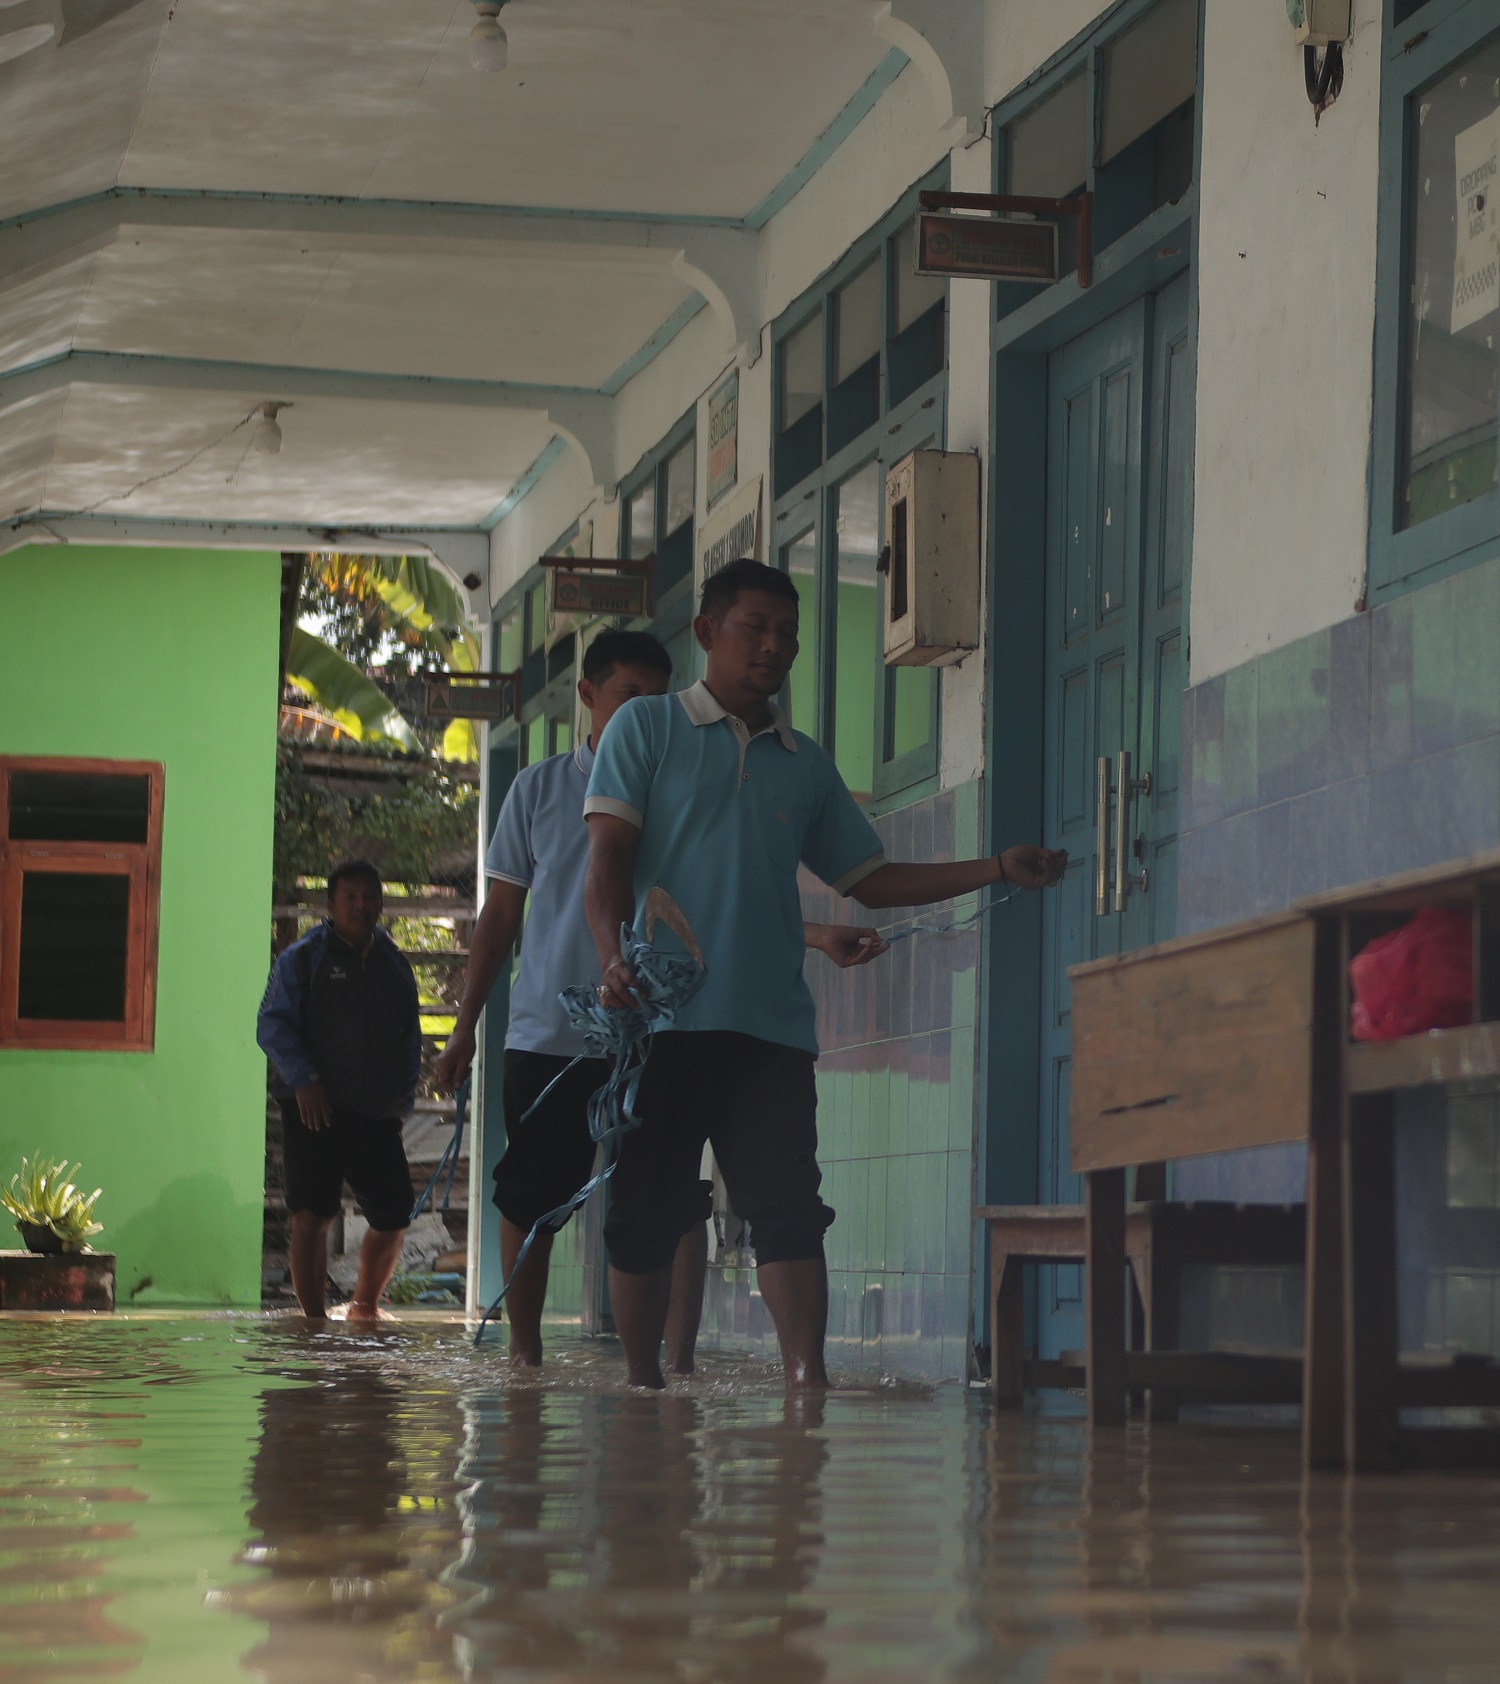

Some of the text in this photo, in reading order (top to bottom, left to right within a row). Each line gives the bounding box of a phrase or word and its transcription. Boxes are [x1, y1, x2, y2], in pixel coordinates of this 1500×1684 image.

[1460, 154, 1497, 197] DROPPING
[1469, 211, 1486, 240] MBG
[710, 413, 720, 450] SD
[590, 597, 629, 609] OFFICE
